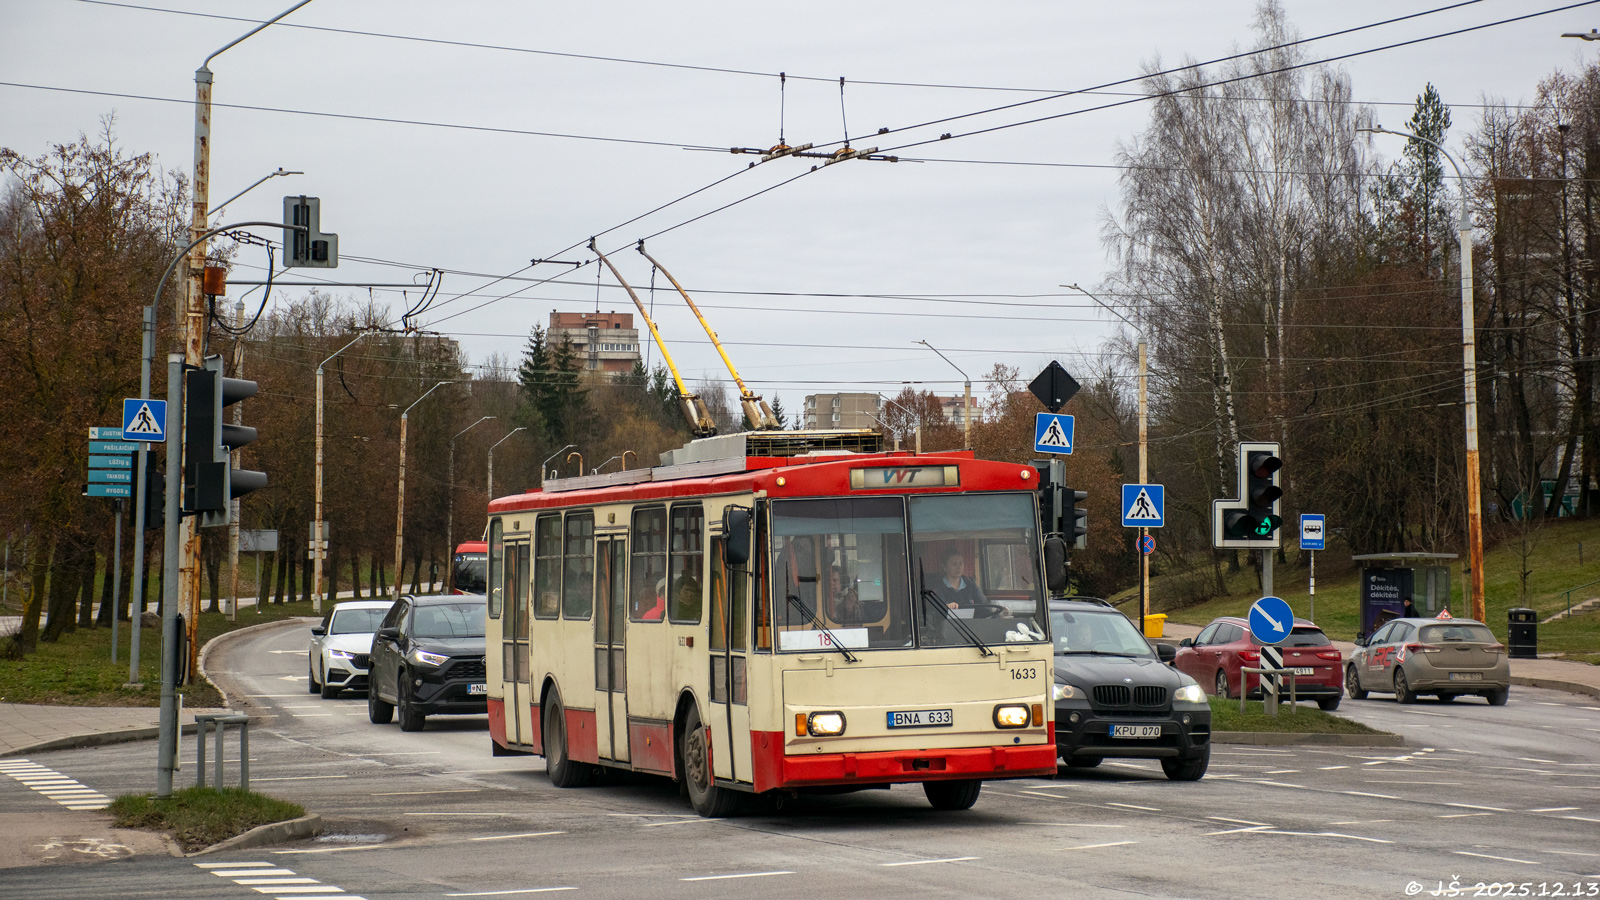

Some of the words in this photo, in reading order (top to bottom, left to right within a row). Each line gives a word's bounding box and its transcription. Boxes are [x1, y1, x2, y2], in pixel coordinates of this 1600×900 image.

[883, 468, 922, 484] VVT
[818, 633, 831, 646] 18
[1010, 668, 1037, 680] 1633
[895, 712, 921, 725] BNA
[928, 711, 950, 723] 633
[1115, 726, 1137, 736] KPU
[1142, 726, 1160, 736] 070
